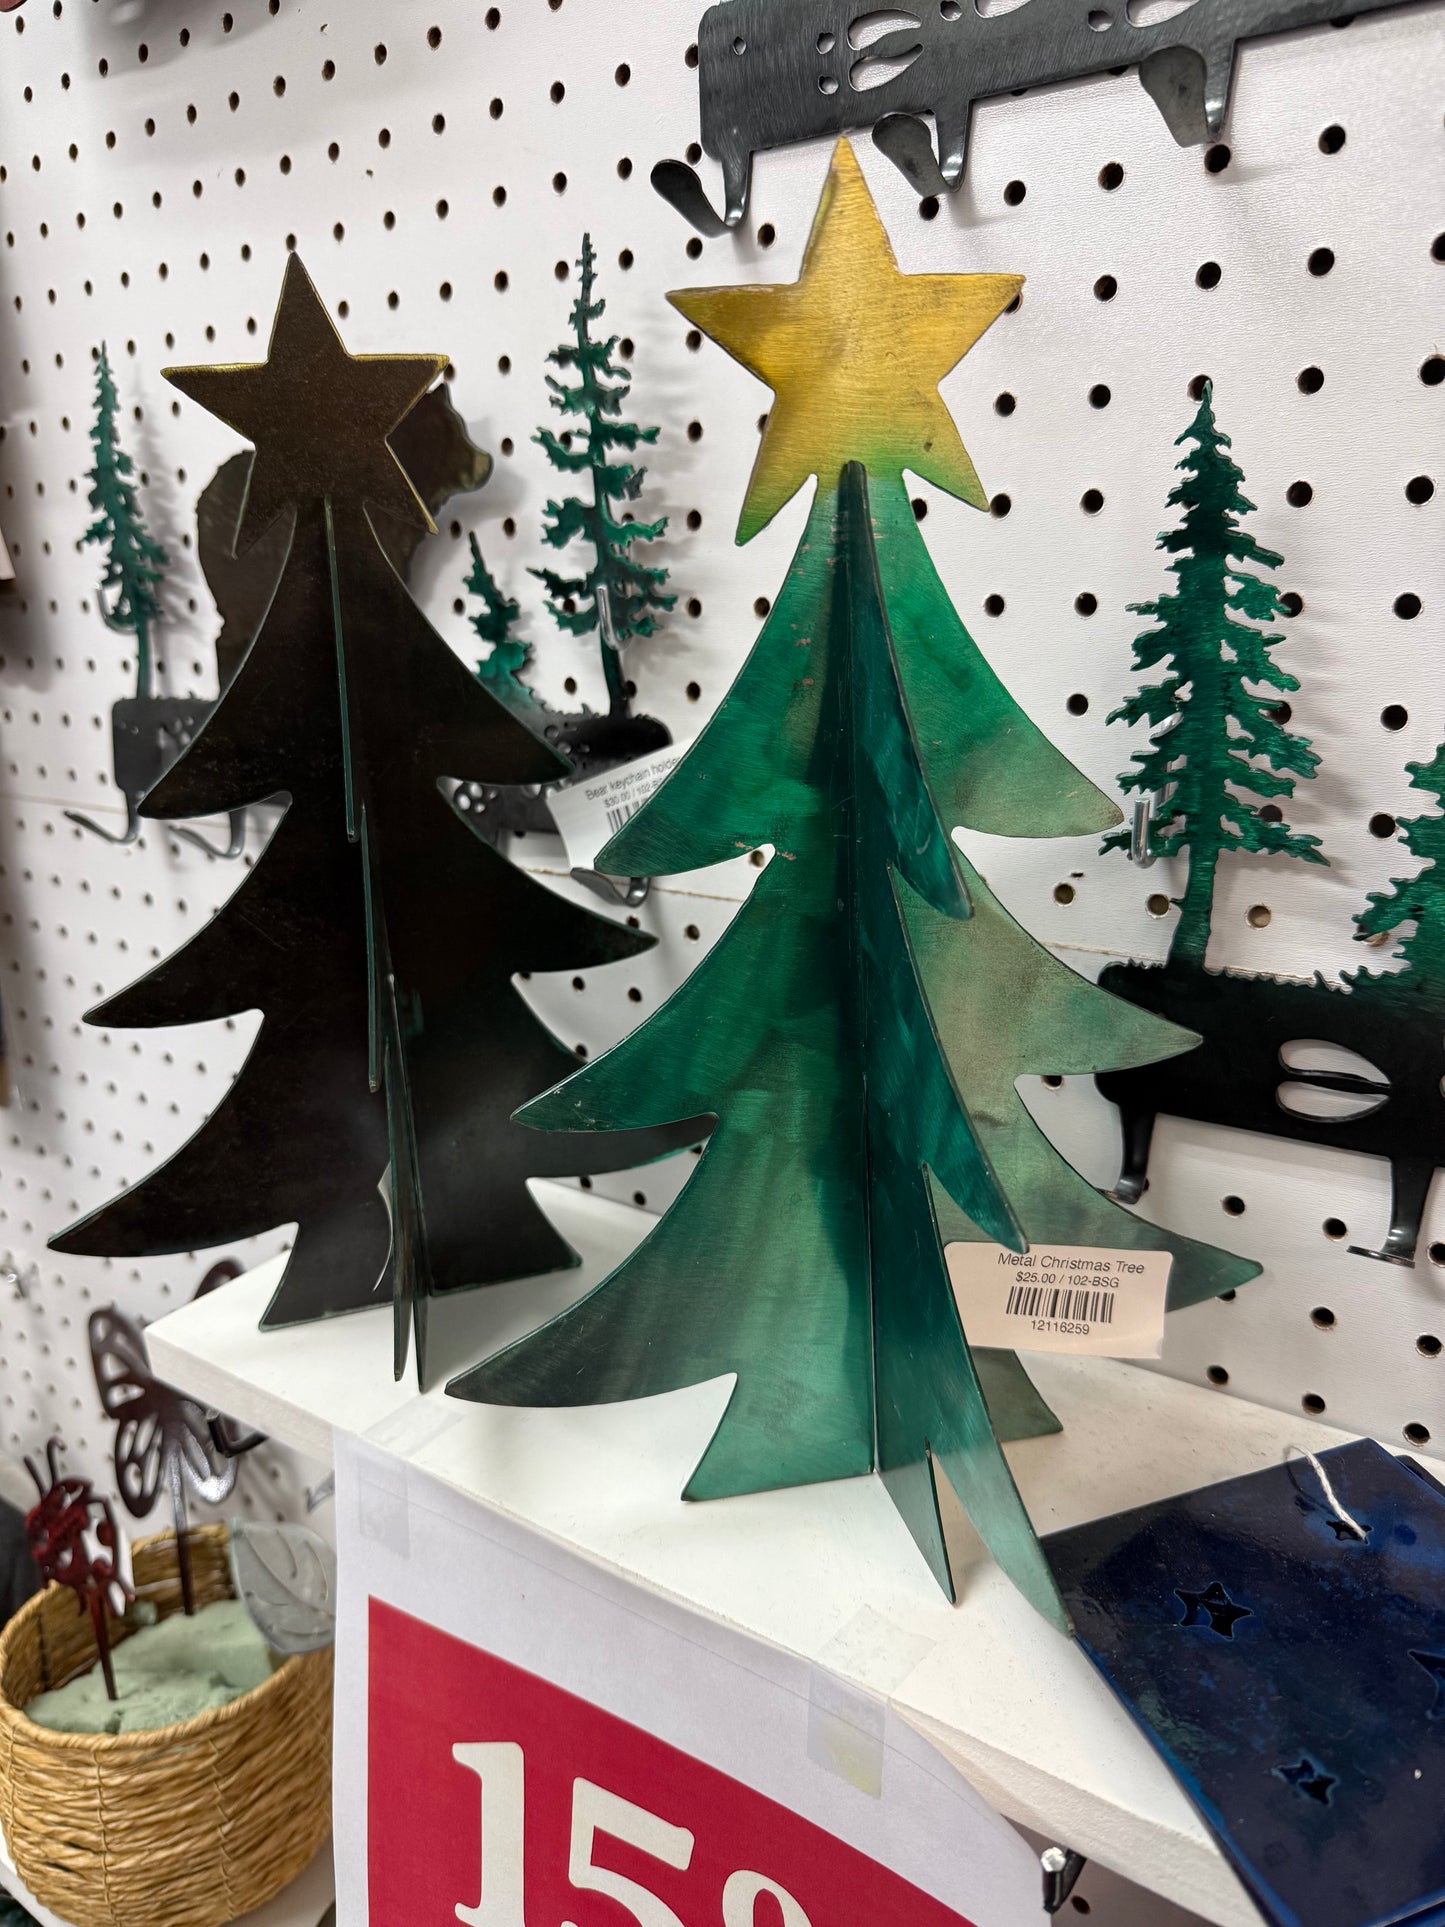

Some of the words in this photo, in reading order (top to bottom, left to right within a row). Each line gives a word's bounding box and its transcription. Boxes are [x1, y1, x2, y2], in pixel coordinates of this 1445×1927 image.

[585, 784, 608, 801] Bear
[609, 769, 651, 791] keychain
[604, 791, 631, 808] $30.00
[997, 1252, 1037, 1268] Metal
[1040, 1255, 1111, 1272] Christmas
[1116, 1260, 1145, 1274] Tree
[1015, 1271, 1056, 1285] $25.00
[1067, 1275, 1120, 1289] 102-BSG
[1031, 1319, 1091, 1336] 12116259
[452, 1741, 814, 1927] 15
